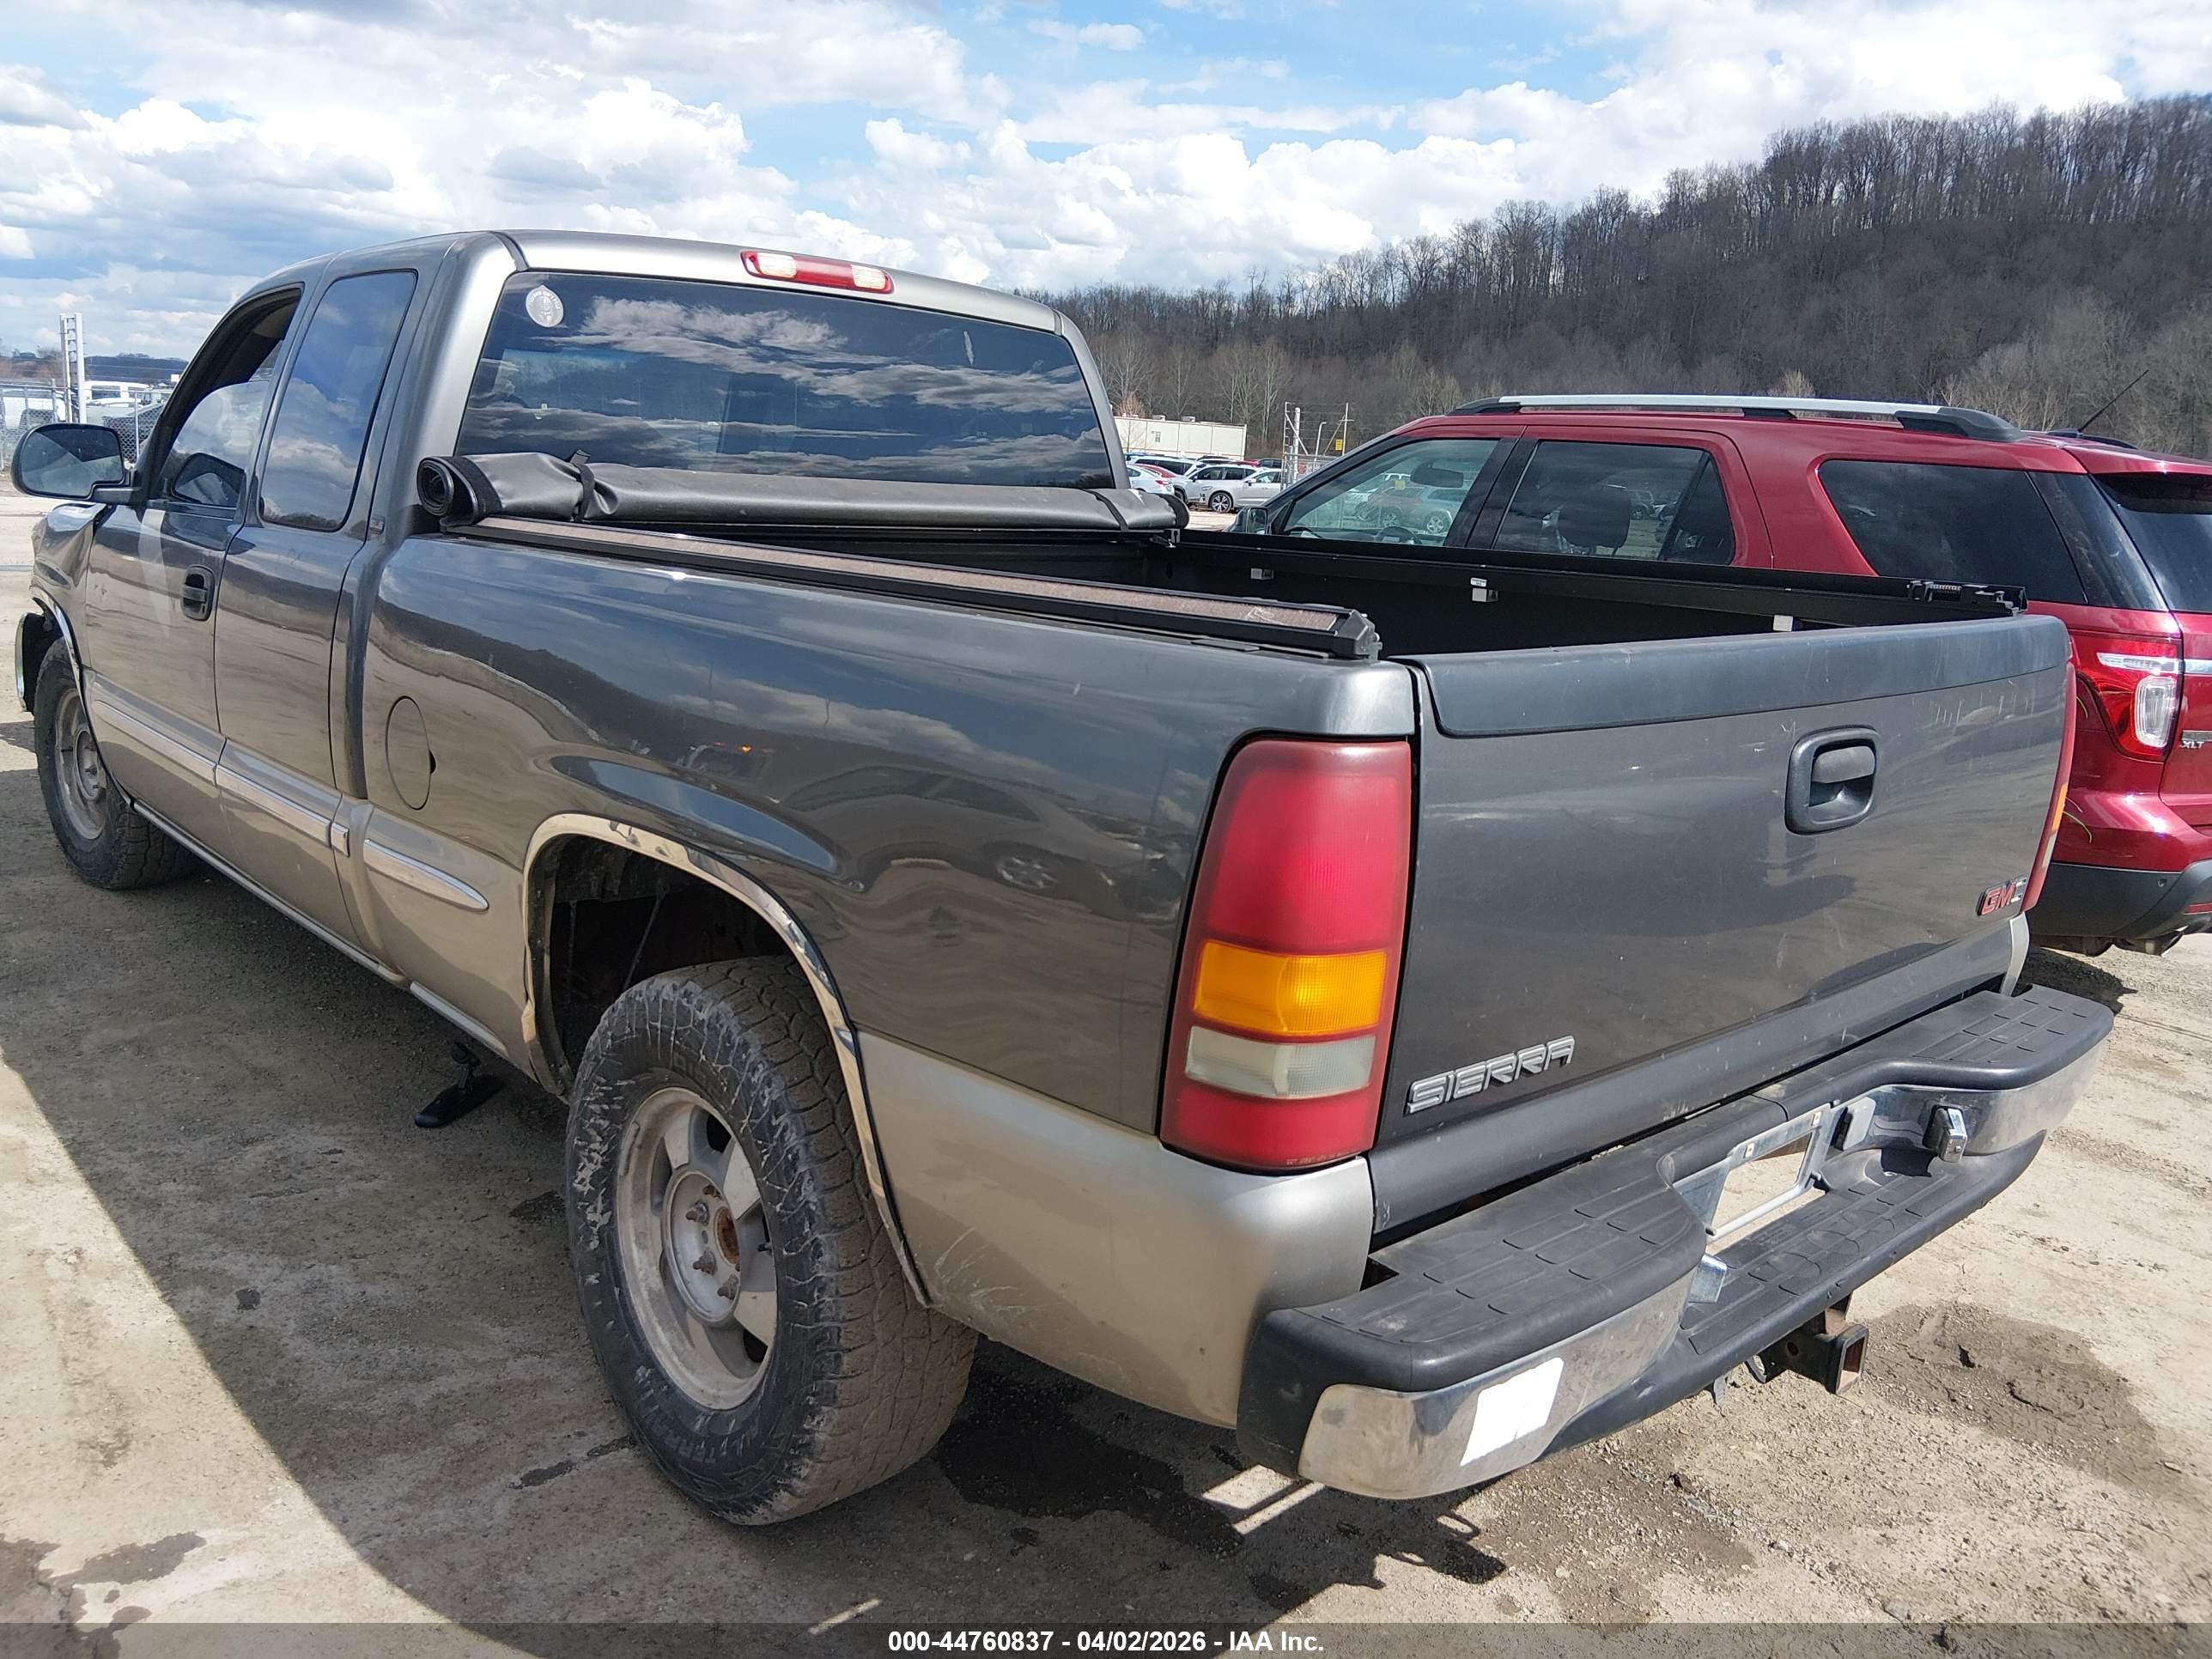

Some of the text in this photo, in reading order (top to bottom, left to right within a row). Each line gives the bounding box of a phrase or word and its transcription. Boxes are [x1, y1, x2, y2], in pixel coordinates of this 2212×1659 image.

[2180, 739, 2205, 750] XLT
[1979, 875, 2027, 916] GMC
[1407, 1035, 1576, 1115] SIERRA
